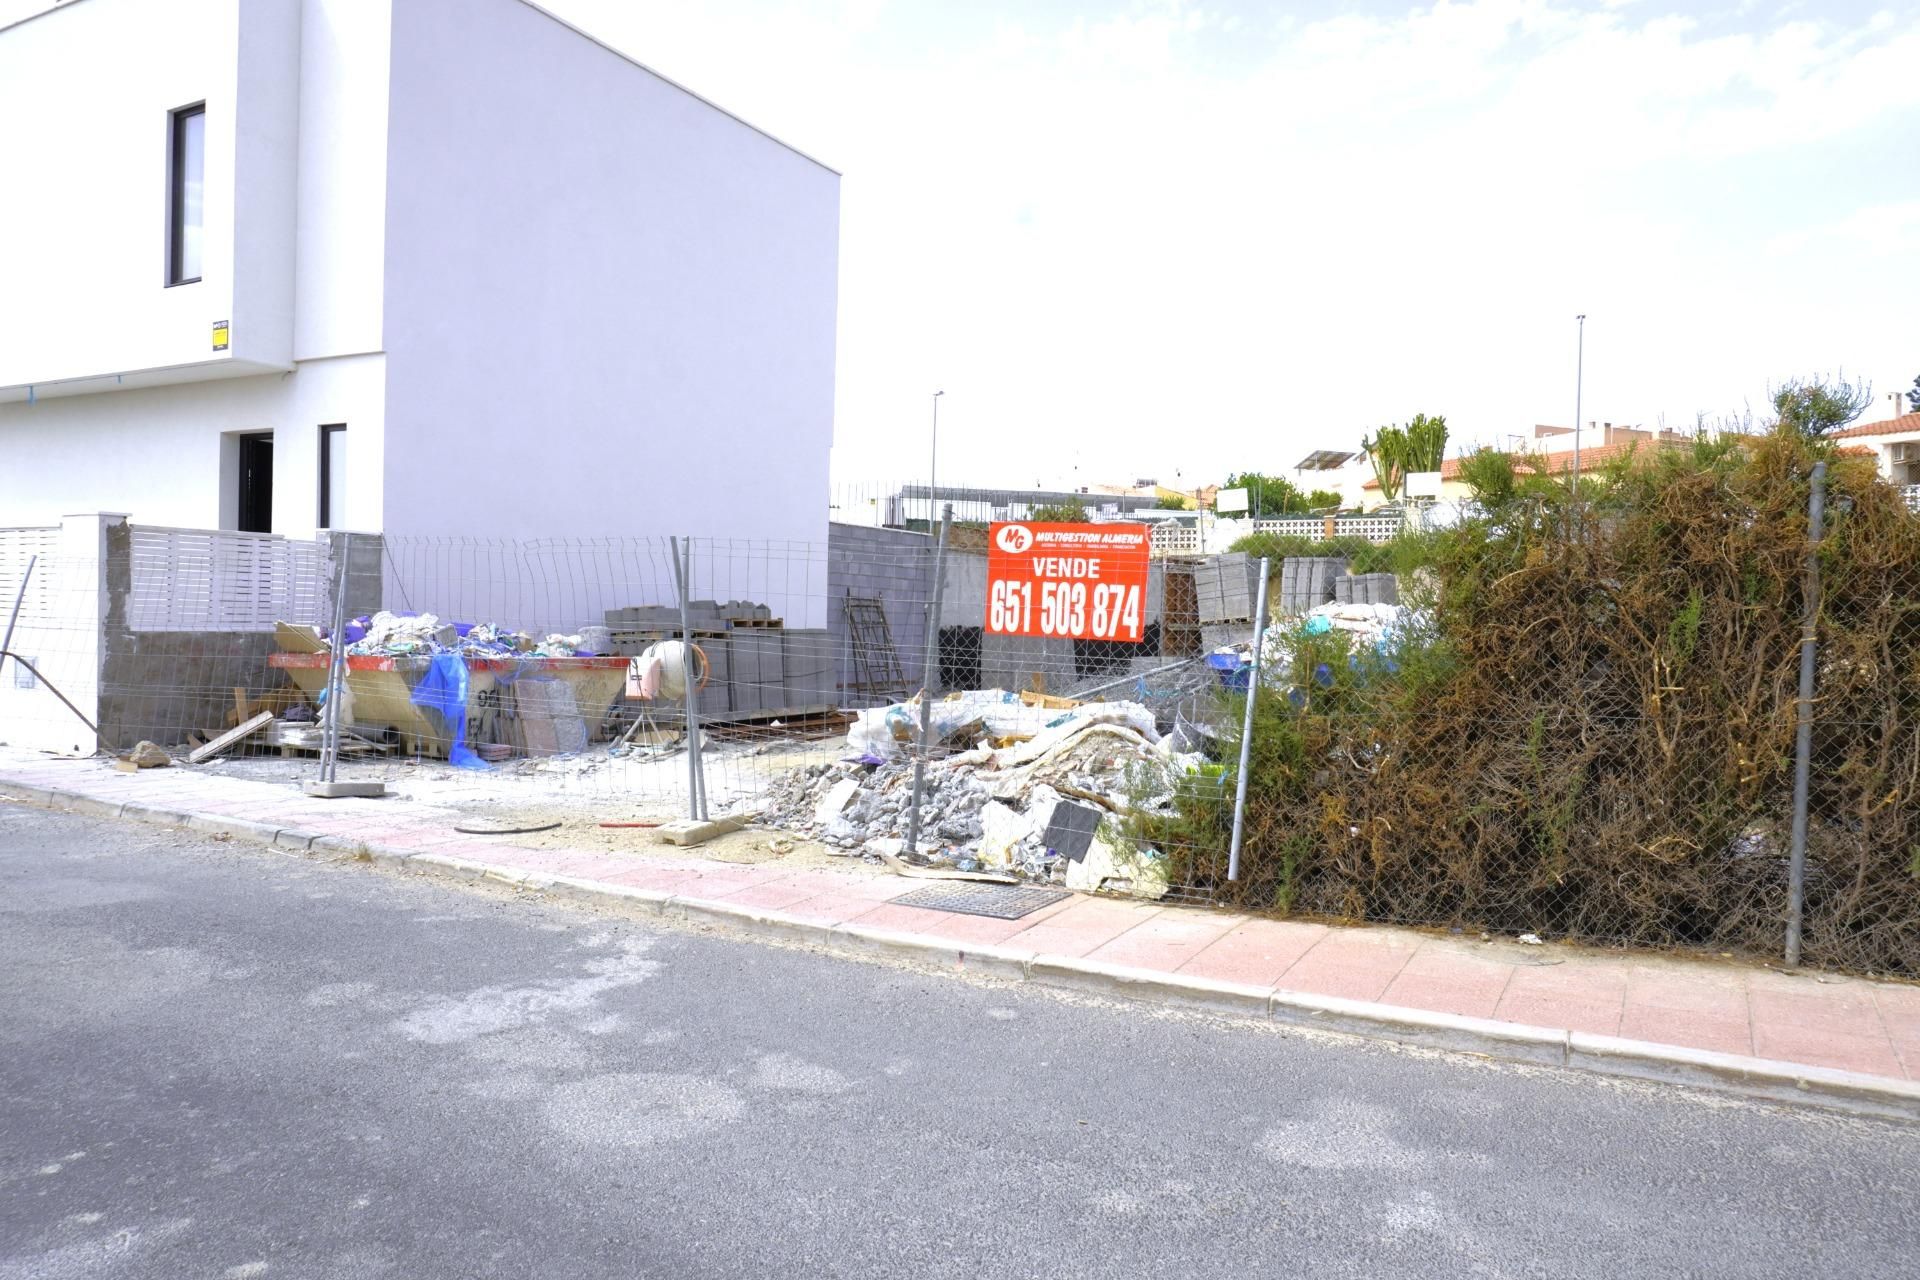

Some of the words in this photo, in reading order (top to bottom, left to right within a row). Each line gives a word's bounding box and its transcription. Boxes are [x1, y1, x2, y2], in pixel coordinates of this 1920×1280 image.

[1005, 529, 1025, 549] MG
[1036, 532, 1101, 543] MULTIGESTION
[1101, 534, 1143, 544] ALMERIA
[1033, 557, 1100, 579] VENDE
[990, 579, 1032, 632] 651
[1041, 581, 1087, 636] 503
[1092, 583, 1140, 638] 874
